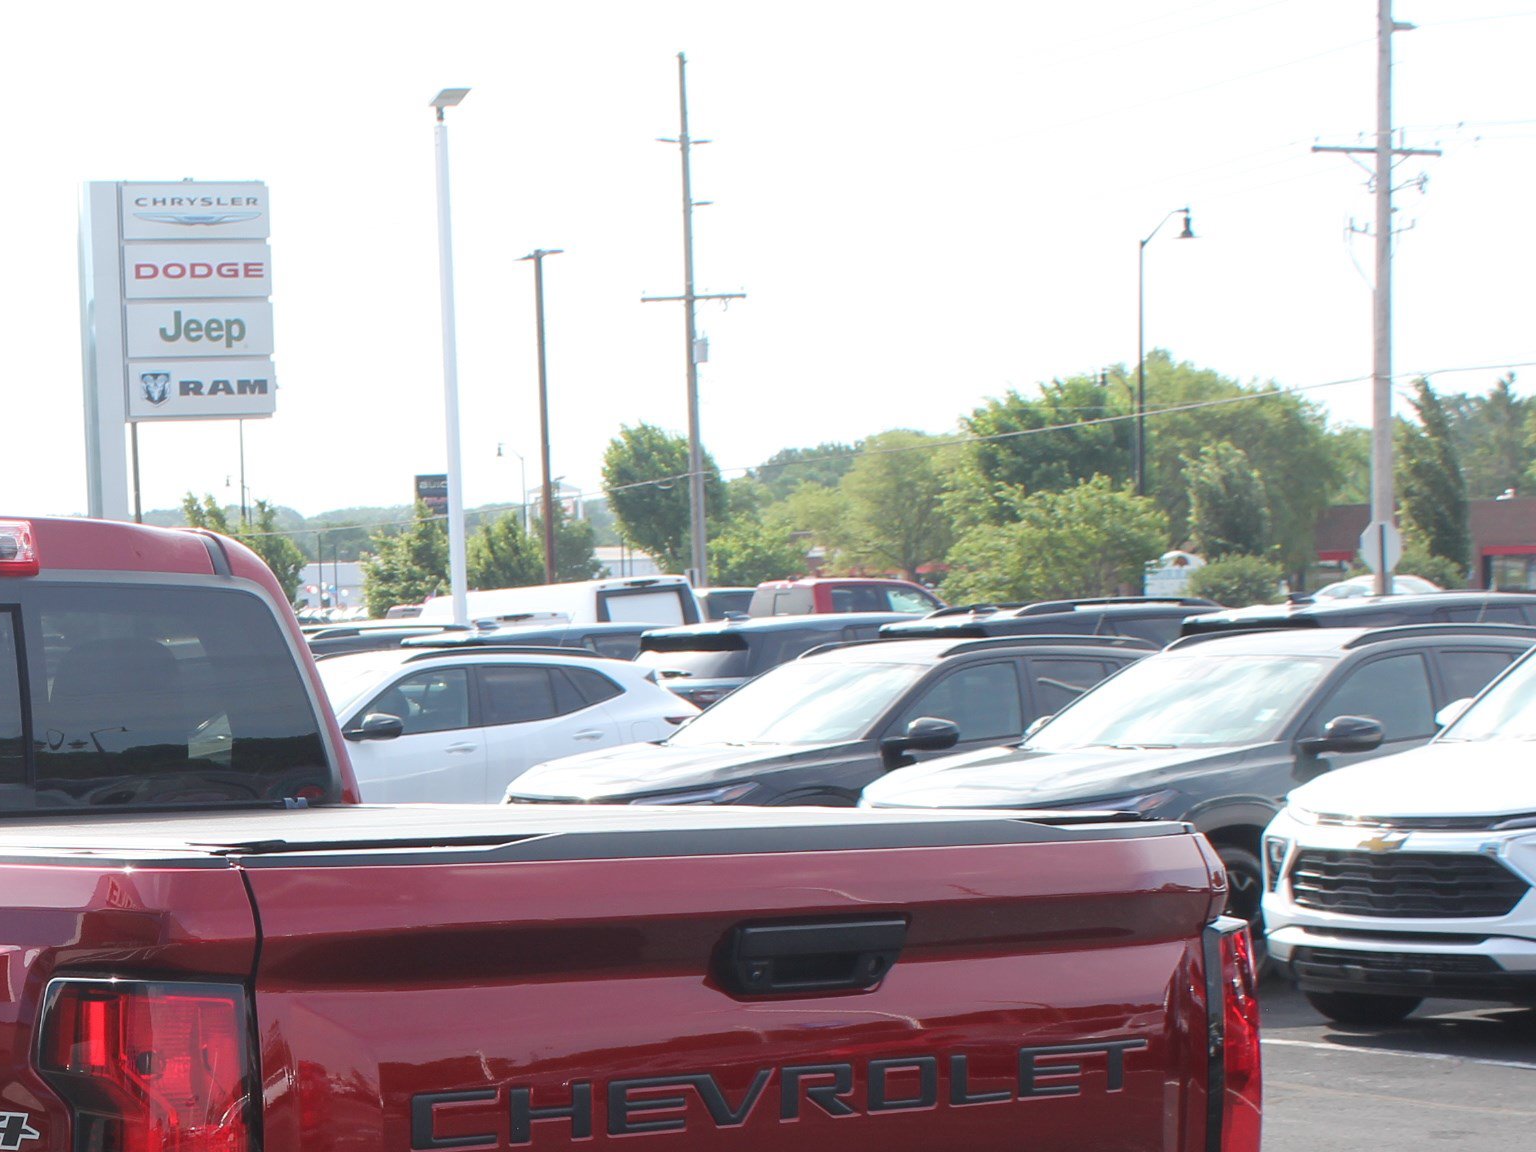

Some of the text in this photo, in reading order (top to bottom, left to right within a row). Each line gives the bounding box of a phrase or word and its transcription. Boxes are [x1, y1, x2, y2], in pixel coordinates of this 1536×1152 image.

[134, 197, 259, 207] CHRYSLER
[134, 262, 265, 280] DODGE
[159, 310, 247, 348] Jeep
[179, 379, 268, 396] RAM
